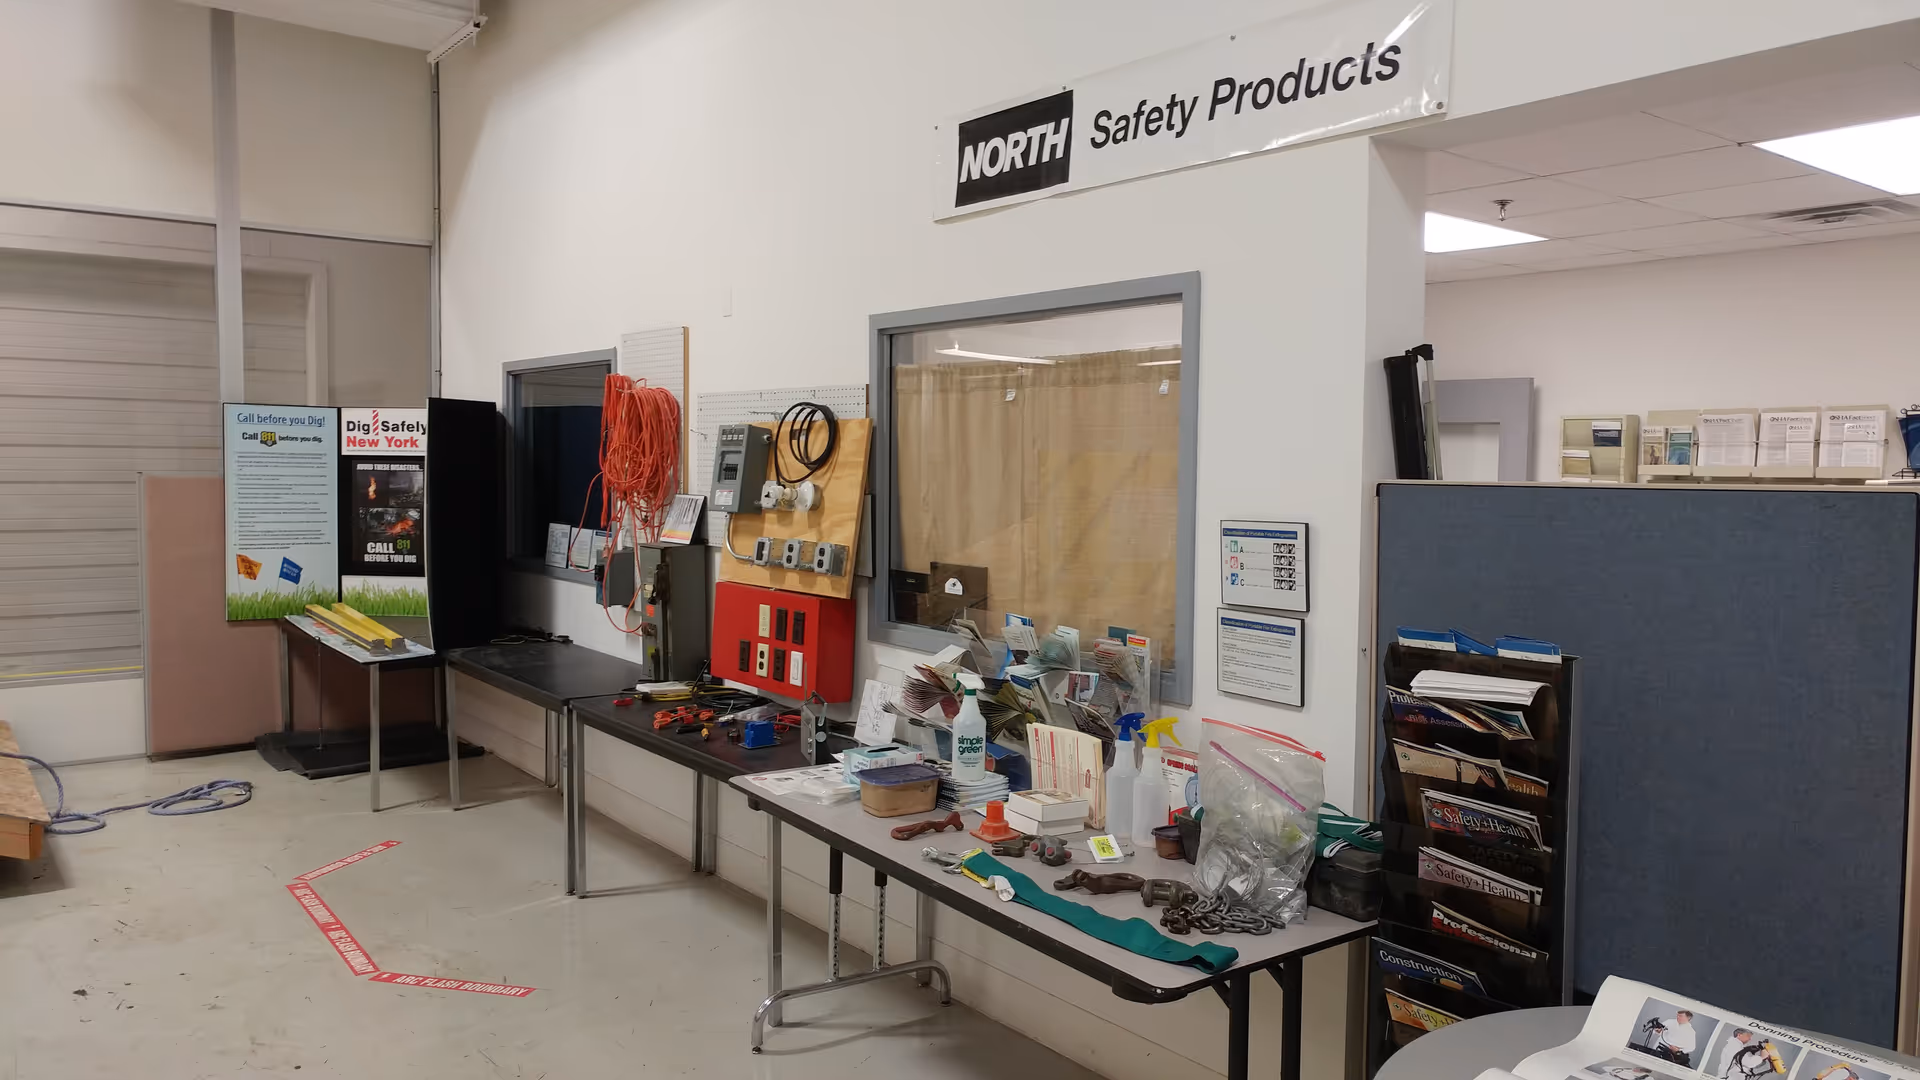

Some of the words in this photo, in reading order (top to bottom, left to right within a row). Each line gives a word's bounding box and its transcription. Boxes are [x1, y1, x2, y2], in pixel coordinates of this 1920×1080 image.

[959, 118, 1071, 183] NORTH
[1090, 93, 1199, 150] Safety
[1208, 41, 1401, 121] Products
[237, 413, 255, 423] Call
[257, 414, 287, 424] before
[289, 417, 305, 426] you
[308, 416, 326, 427] Dig!
[346, 420, 370, 435] Dig
[381, 420, 427, 435] Safely
[242, 432, 259, 441] Call
[262, 432, 276, 442] 811
[346, 436, 380, 448] New
[384, 436, 419, 448] York
[367, 542, 395, 554] CALL
[396, 539, 411, 549] 811
[1239, 546, 1245, 554] A
[364, 554, 389, 562] BEFORE
[390, 554, 403, 563] YOU
[404, 555, 417, 563] DIG
[1239, 562, 1245, 571] B
[958, 735, 983, 747] simple
[958, 745, 983, 756] green
[1432, 908, 1537, 959] Professional
[1379, 949, 1463, 982] Construction
[392, 975, 423, 985] ARC
[420, 977, 462, 989] FLASH
[459, 980, 529, 996] BOUNDARY
[1748, 1021, 1802, 1043] Donning
[1802, 1037, 1870, 1065] Procedure
